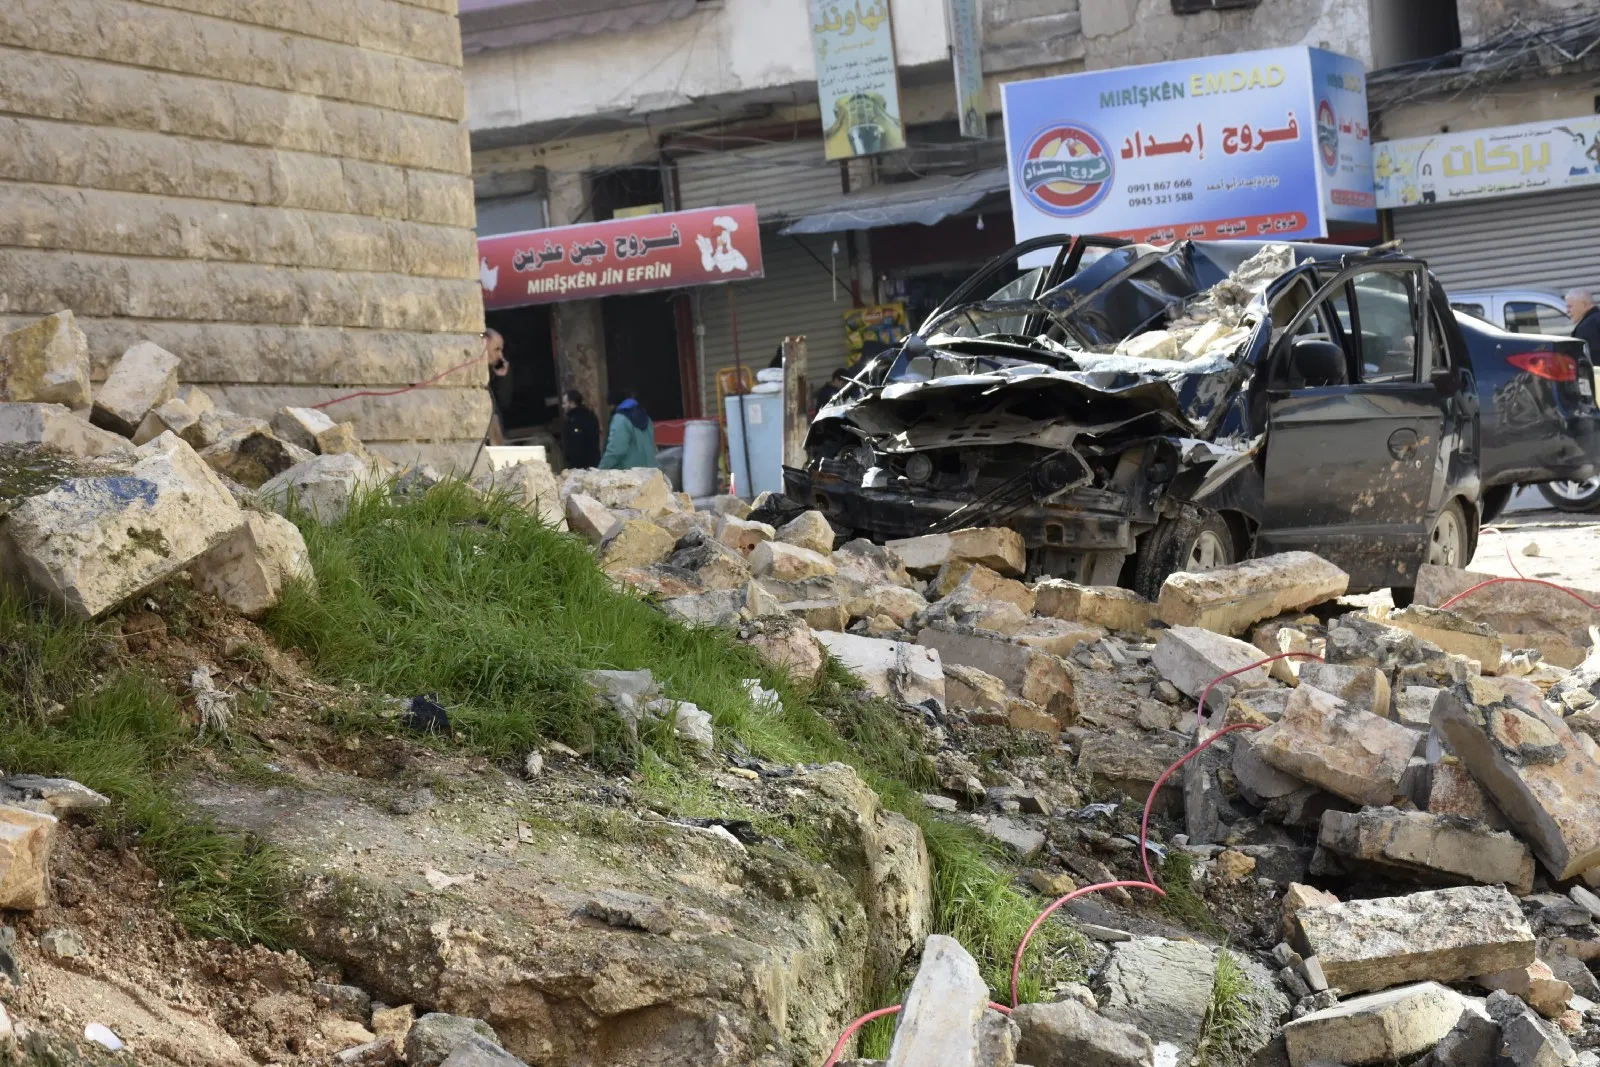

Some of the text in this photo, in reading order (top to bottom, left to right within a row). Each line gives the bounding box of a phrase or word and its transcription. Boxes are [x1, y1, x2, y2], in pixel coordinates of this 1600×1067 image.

[814, 0, 887, 36] نهاوند
[1190, 65, 1286, 97] EMDAD
[1121, 122, 1204, 160] إمداد
[1222, 111, 1299, 155] فروج
[1443, 137, 1552, 178] بركات
[1127, 178, 1193, 194] 0991 867 666
[1128, 192, 1194, 208] 0945 321 588
[513, 222, 682, 272] فروج جين عفرين
